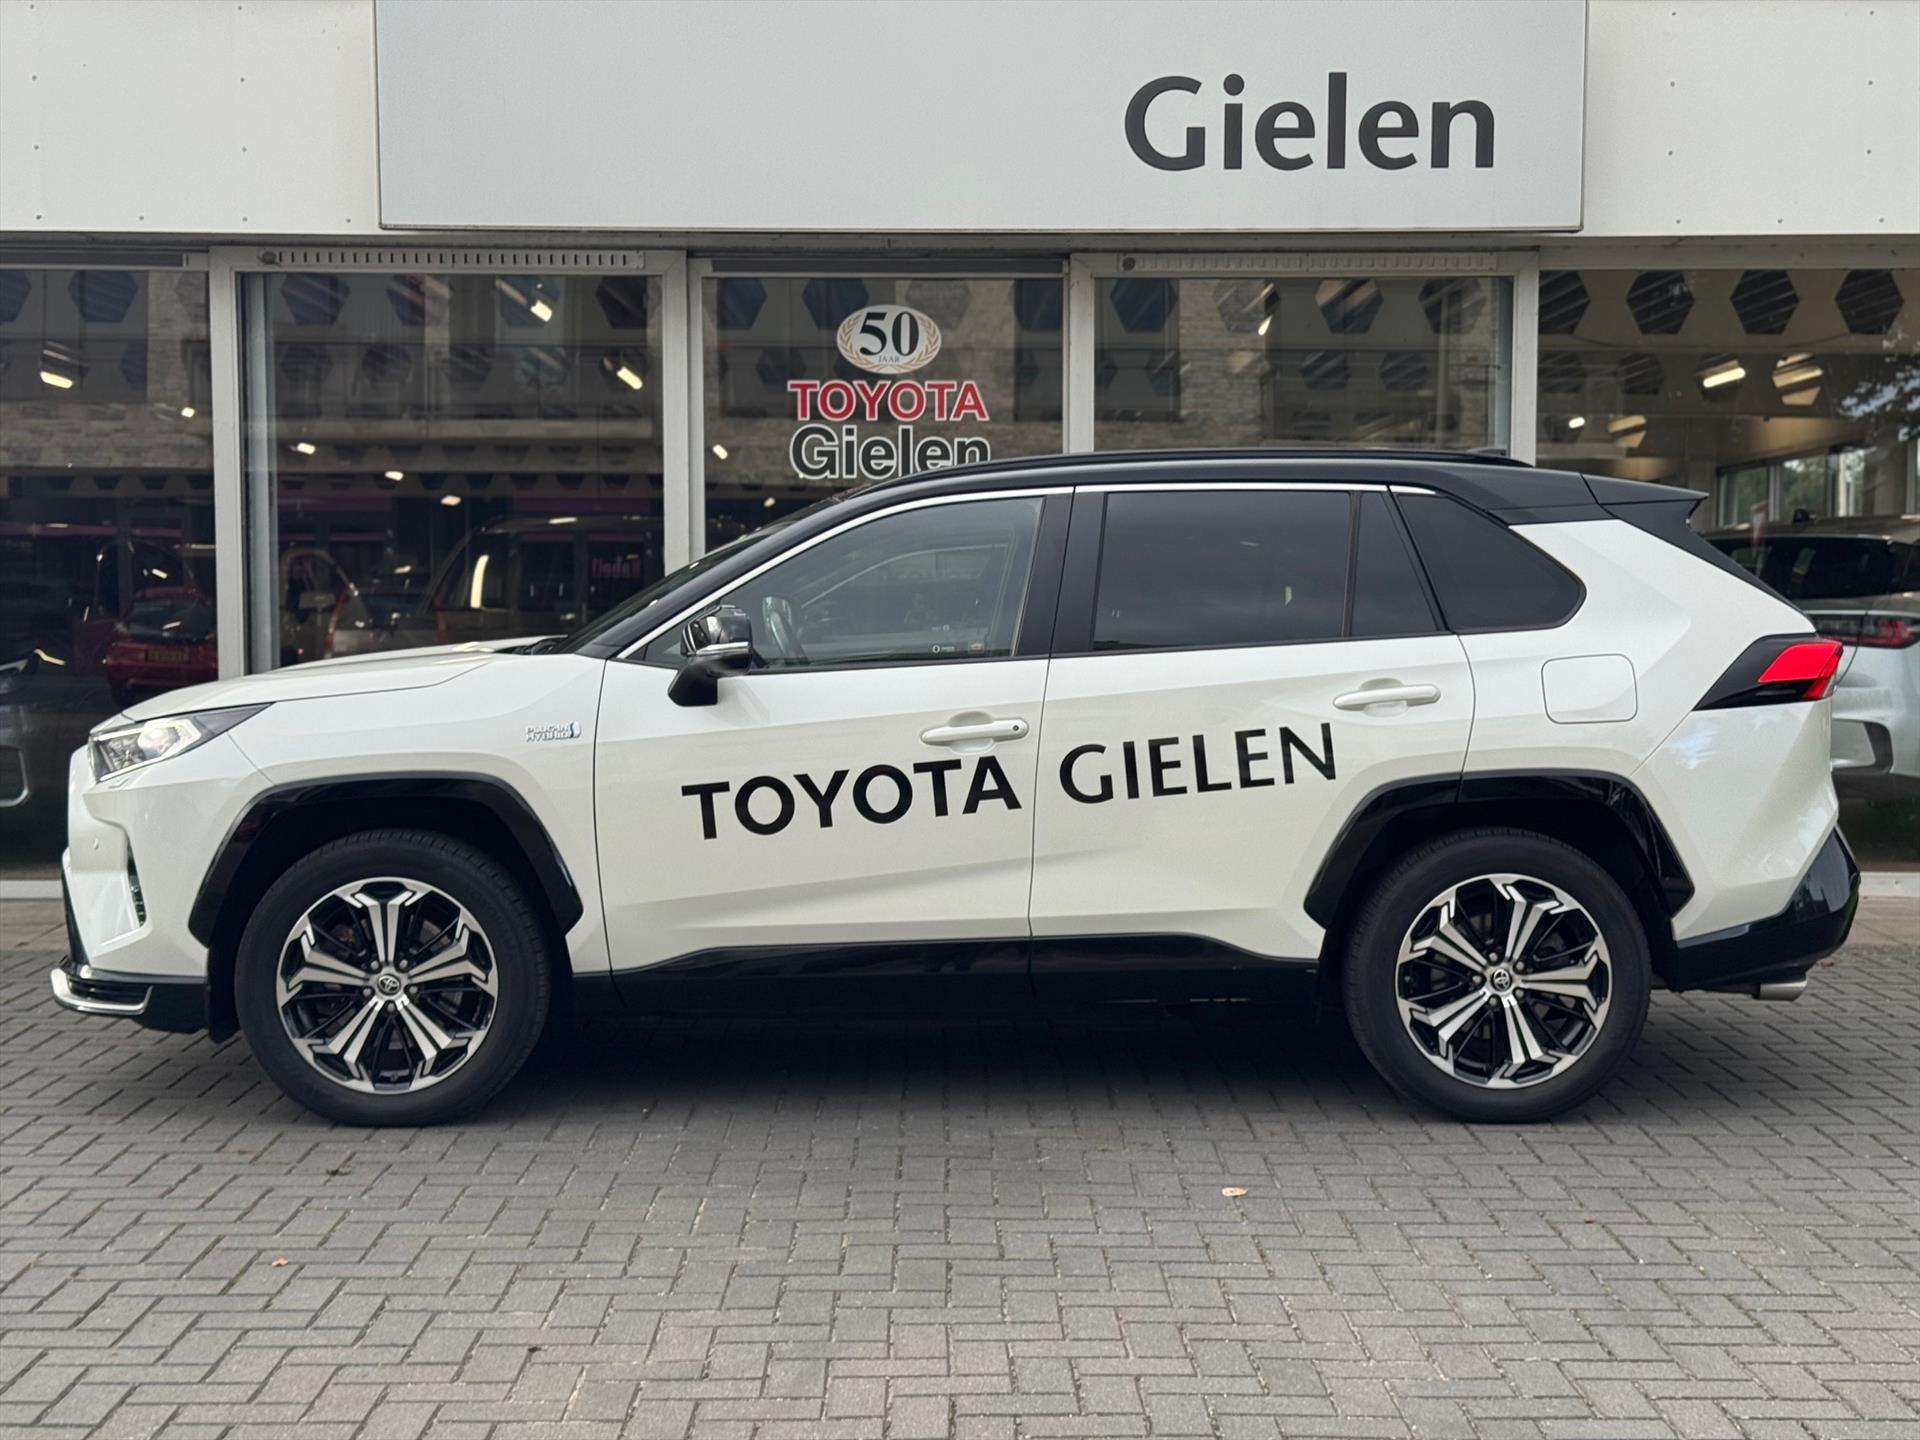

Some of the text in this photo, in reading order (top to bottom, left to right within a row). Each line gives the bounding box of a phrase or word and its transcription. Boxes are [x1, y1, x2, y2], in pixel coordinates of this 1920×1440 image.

[1124, 71, 1495, 172] Gielen
[858, 311, 919, 356] 50
[787, 380, 990, 421] TOYOTA
[789, 423, 991, 479] Gielen
[681, 722, 1337, 840] TOYOTA GIELEN
